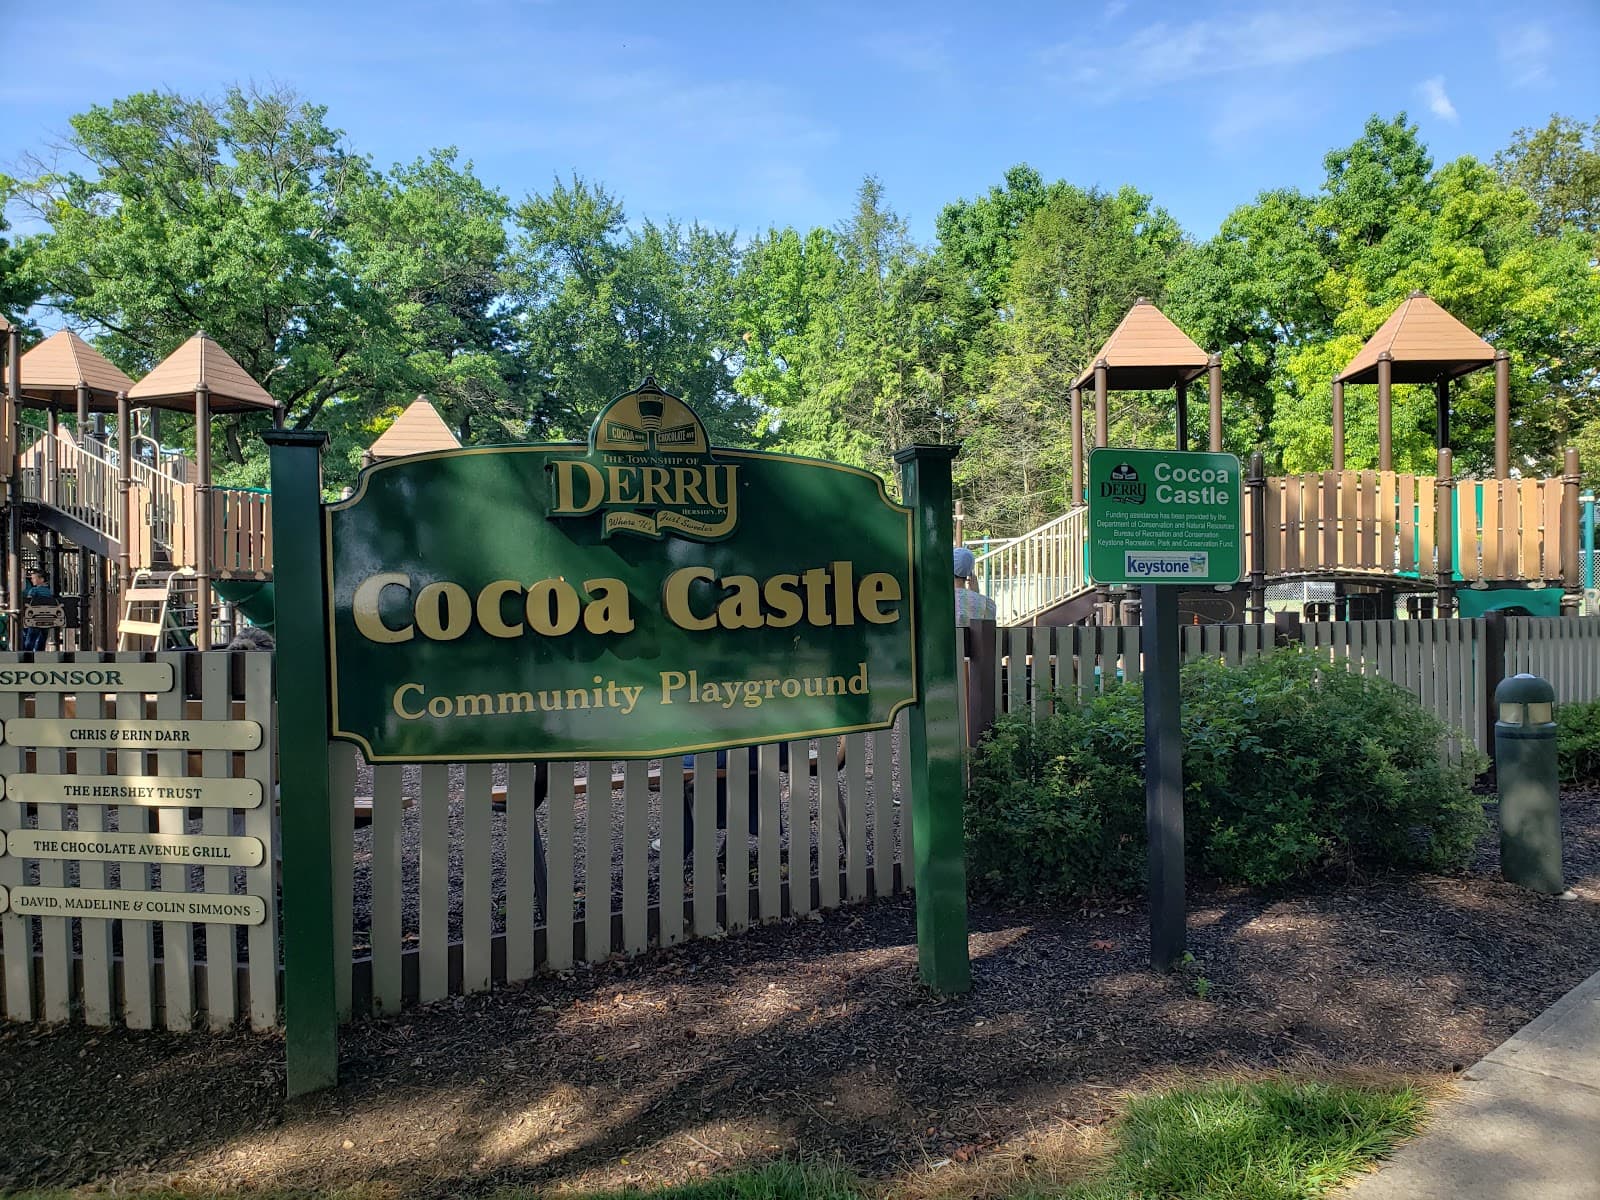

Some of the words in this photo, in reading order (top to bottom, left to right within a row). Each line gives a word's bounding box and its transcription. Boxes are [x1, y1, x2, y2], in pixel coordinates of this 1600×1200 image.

[657, 430, 686, 442] CHOCOLATE
[628, 455, 682, 465] TOWNSHIP
[1154, 463, 1228, 483] Cocoa
[551, 461, 739, 525] DERRY
[1101, 482, 1146, 505] DERRY
[1156, 485, 1229, 505] Castle
[1097, 520, 1129, 528] Department
[1106, 511, 1128, 519] Funding
[1210, 513, 1217, 521] by
[352, 571, 636, 643] Cocoa
[662, 560, 902, 632] Castle
[0, 671, 124, 686] SPONSOR
[391, 675, 644, 720] Community
[659, 662, 870, 709] Playground
[70, 730, 107, 740] CHRIS
[110, 730, 120, 740] &
[122, 730, 152, 741] ERIN
[155, 731, 190, 741] DARR
[64, 785, 90, 796] THE
[93, 786, 154, 797] HERSHEY
[157, 787, 202, 799] TRUST
[34, 841, 58, 851] THE
[61, 842, 136, 855] CHOCOLATE
[139, 845, 190, 856] AVENUE
[193, 847, 231, 858] GRILL
[21, 896, 62, 909] DAVID,
[65, 898, 130, 911] MADELINE
[133, 900, 143, 911] &
[147, 901, 185, 913] COLIN
[189, 903, 250, 916] SIMMONS
